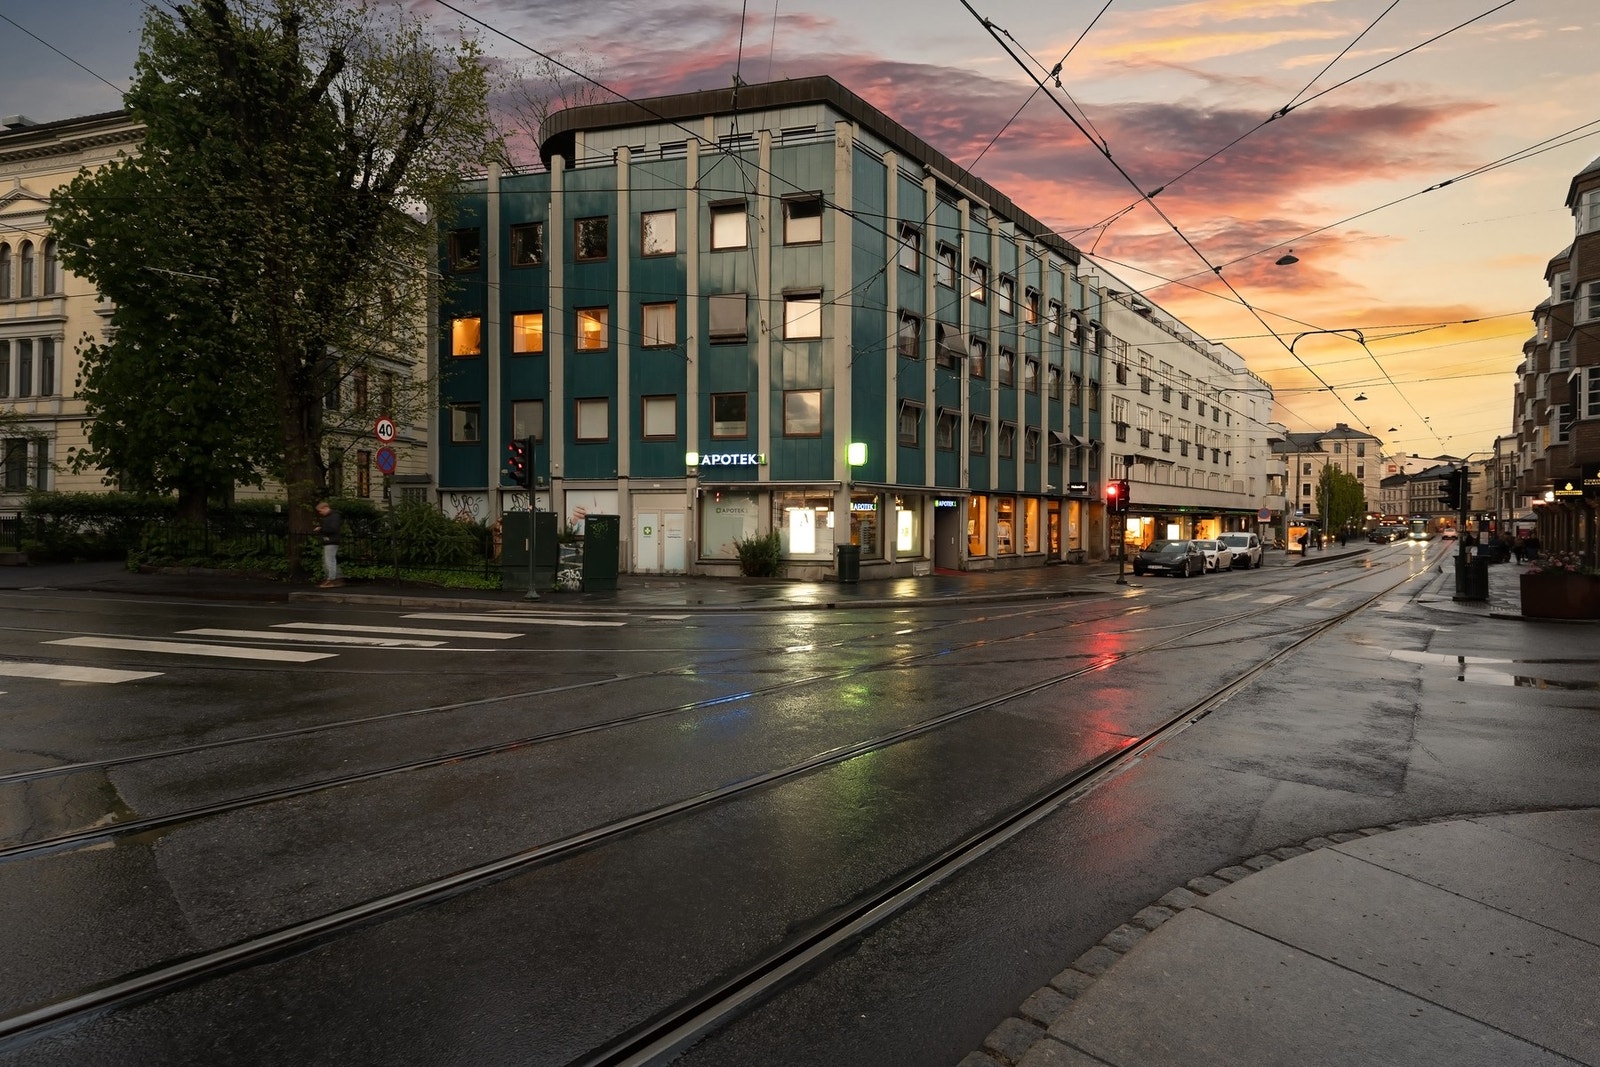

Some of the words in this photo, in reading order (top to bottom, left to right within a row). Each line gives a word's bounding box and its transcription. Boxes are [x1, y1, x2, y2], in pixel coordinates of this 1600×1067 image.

[379, 424, 393, 437] 40
[701, 454, 758, 465] APOTEK
[760, 453, 767, 465] 1
[853, 503, 873, 511] APOTEK
